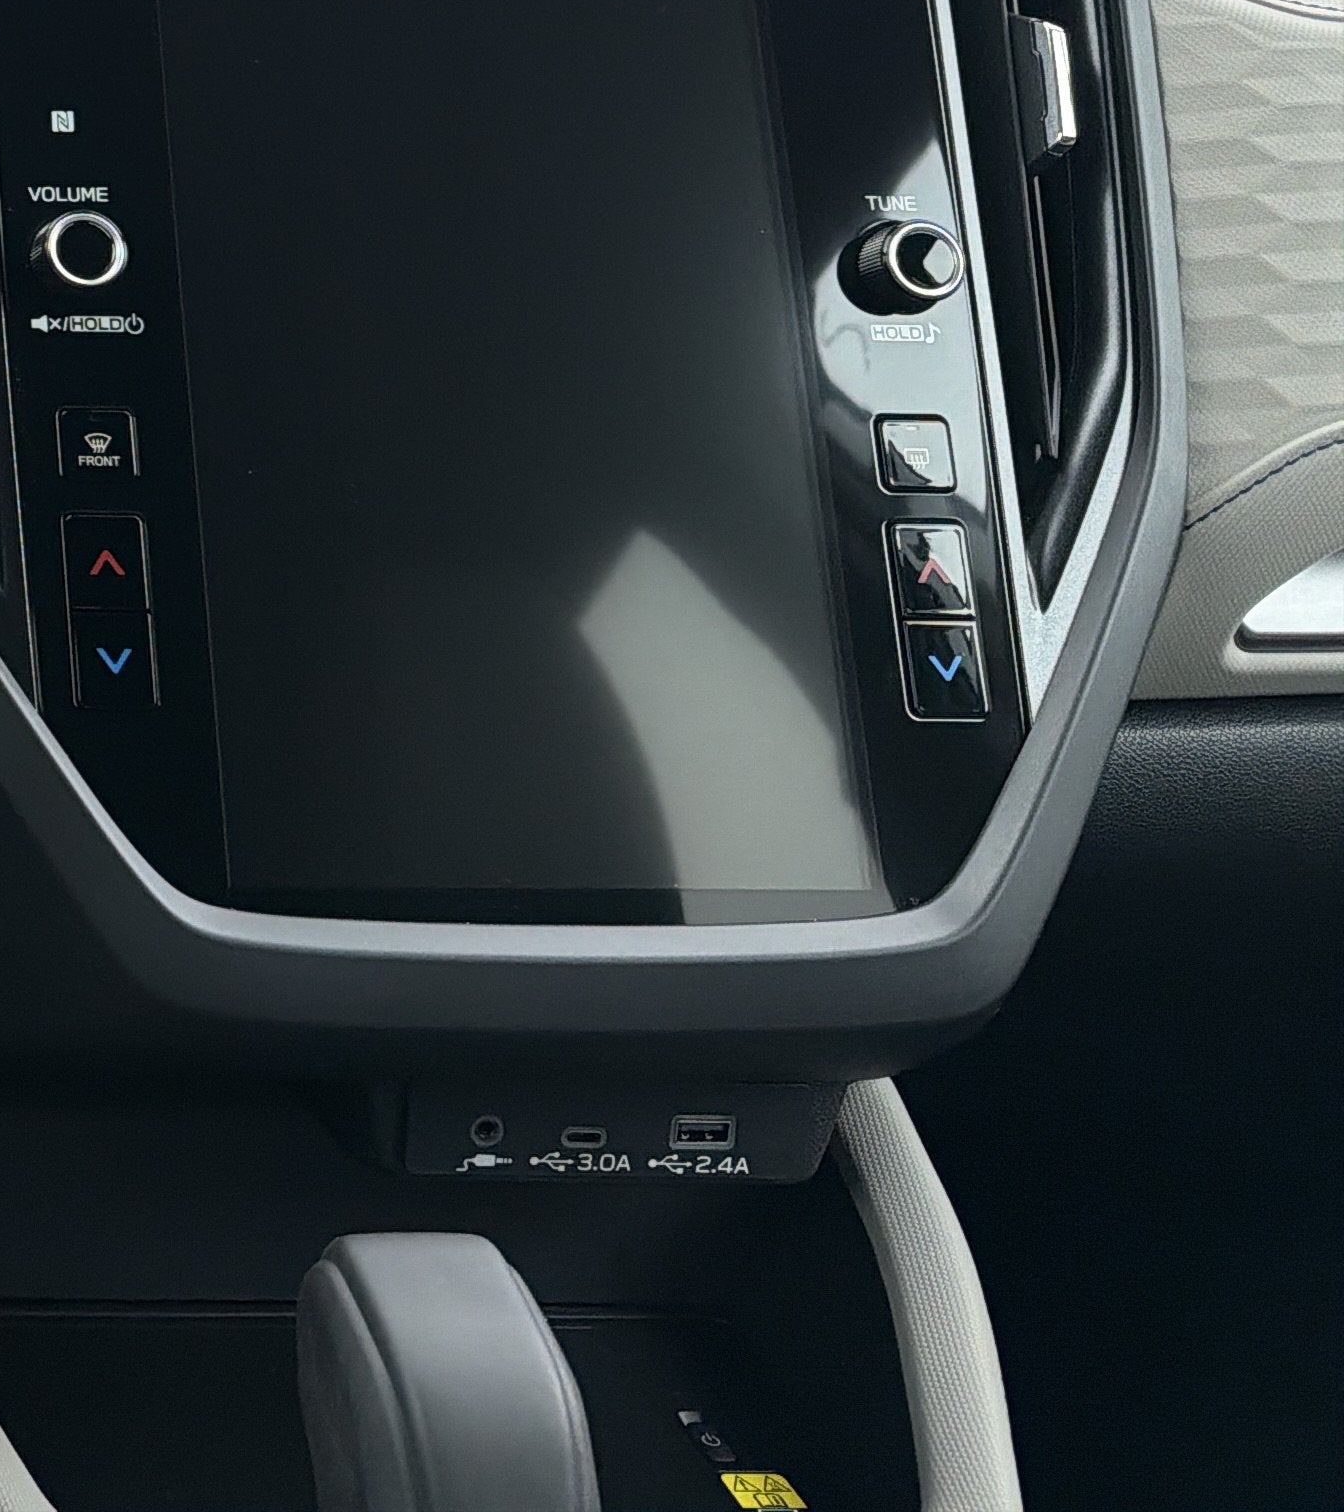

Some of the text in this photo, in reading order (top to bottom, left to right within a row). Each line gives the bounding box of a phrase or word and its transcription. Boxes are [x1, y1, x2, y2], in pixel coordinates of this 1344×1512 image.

[27, 186, 110, 203] VOLUME
[864, 195, 918, 212] TUNE
[872, 325, 923, 340] HOLD
[78, 455, 120, 467] FRONT
[576, 1152, 631, 1172] 3.0A
[695, 1155, 749, 1175] 2.4A
